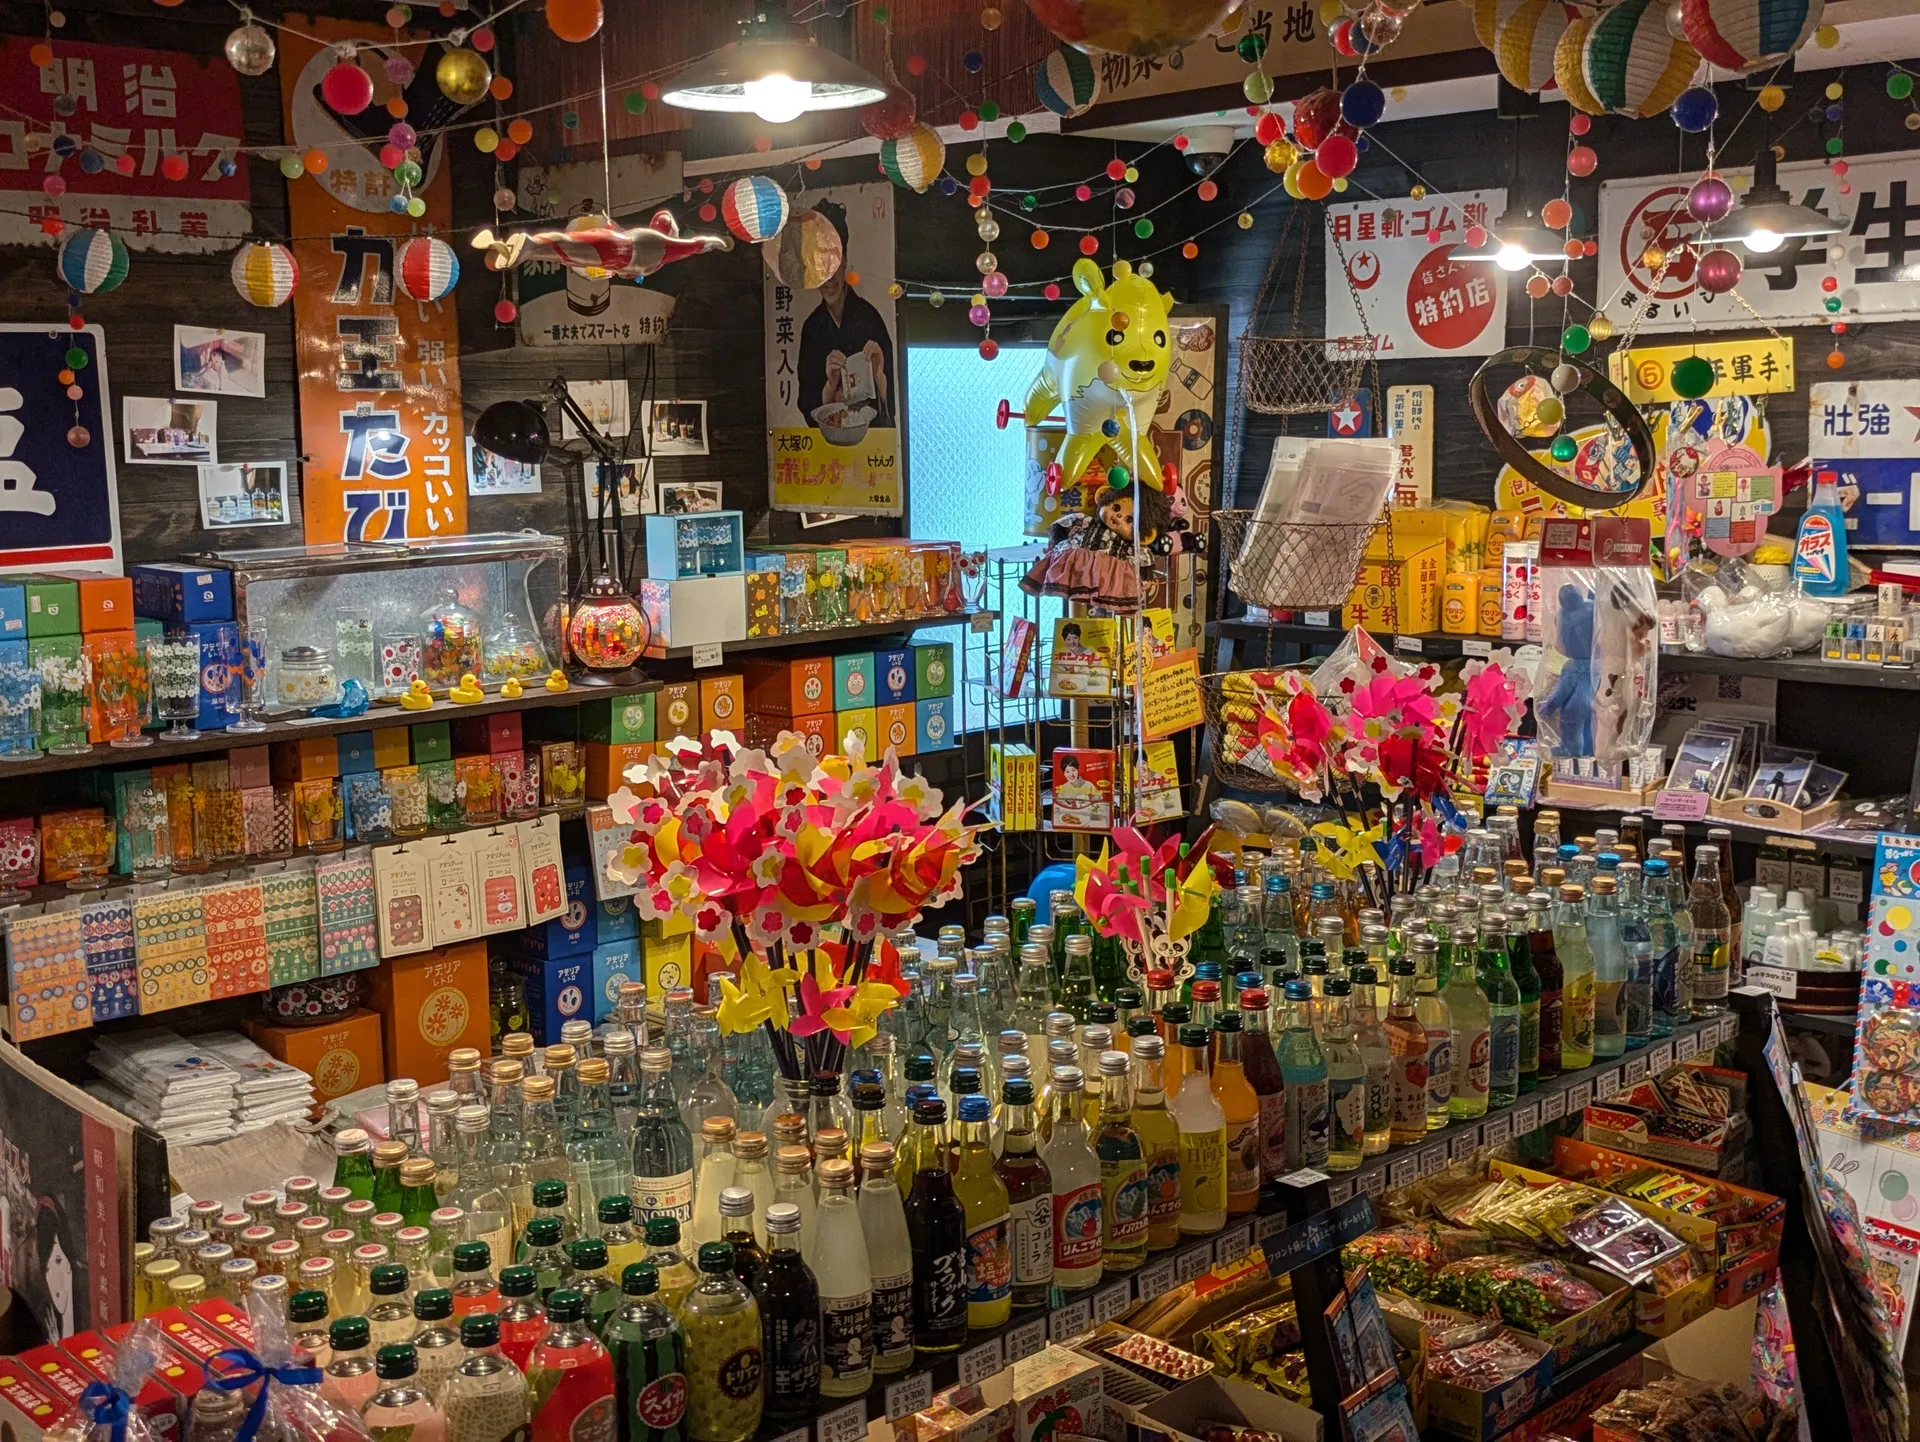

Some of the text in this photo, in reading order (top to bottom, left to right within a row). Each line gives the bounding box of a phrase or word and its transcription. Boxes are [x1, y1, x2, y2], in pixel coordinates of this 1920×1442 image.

[40, 57, 177, 118] 明治
[1414, 277, 1492, 327] 特約店
[543, 323, 631, 341] 一番丈夫でスマートな
[775, 285, 795, 407] 野菜入り
[1672, 351, 1780, 387] 年軍手
[777, 434, 813, 452] 大塚の
[1399, 444, 1415, 480] 君が代
[422, 412, 454, 532] カッコいい
[869, 494, 891, 503] 大塚食品
[1800, 532, 1832, 553] ガラス
[567, 879, 586, 890] デリア
[605, 953, 629, 965] アデリア
[424, 960, 461, 980] アデリア
[557, 965, 580, 978] アデリア
[562, 974, 576, 983] レトロ
[432, 974, 454, 987] レトロ
[321, 1030, 350, 1045] アデリア
[1032, 1231, 1041, 1263] コーラ
[932, 1250, 957, 1318] ブラック
[929, 1281, 939, 1313] サイダー
[1108, 1294, 1125, 1308] ¥300
[1065, 1313, 1084, 1325] ¥300
[976, 1353, 995, 1366] ¥300
[645, 1388, 686, 1414] スイカ
[905, 1388, 925, 1401] ¥300
[837, 1416, 859, 1430] ¥300
